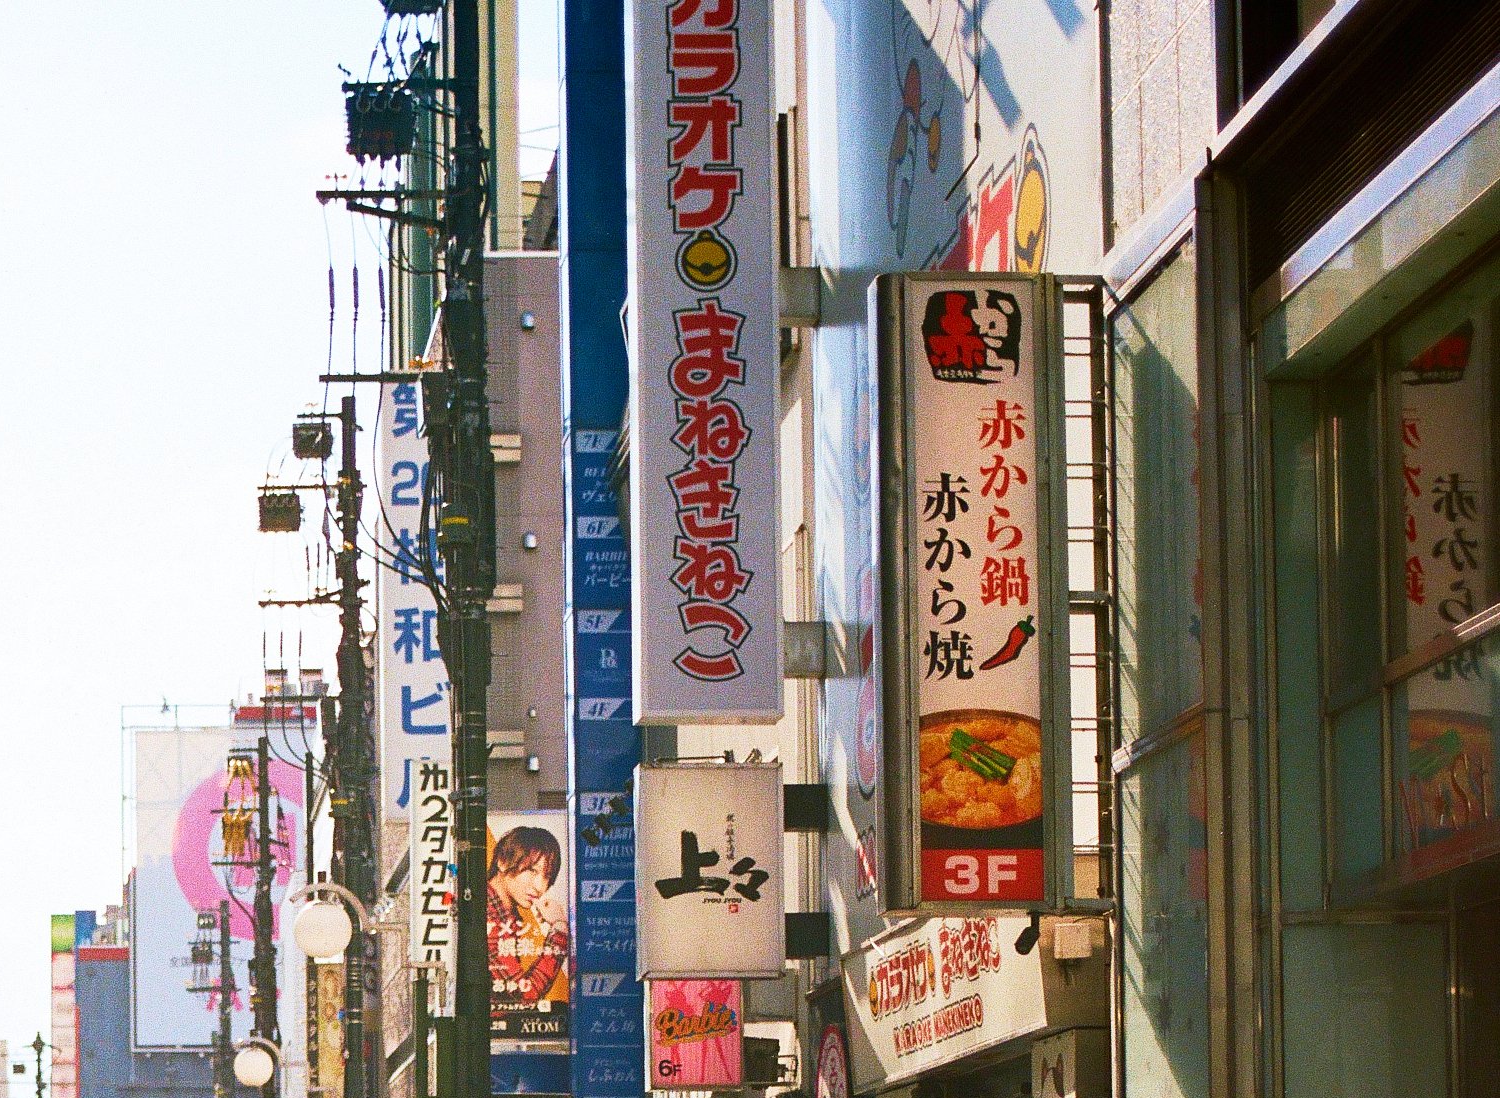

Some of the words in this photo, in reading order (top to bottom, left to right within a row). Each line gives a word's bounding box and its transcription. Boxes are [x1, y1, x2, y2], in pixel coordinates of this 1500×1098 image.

[668, 300, 753, 684] まねきねこ
[976, 400, 1032, 609] 赤から鍋
[921, 473, 975, 683] 赤から焼
[654, 829, 771, 901] 上々
[942, 854, 1018, 895] 3F
[875, 940, 928, 1014] カラオケ
[938, 916, 1002, 998] まねきねこ
[520, 1022, 560, 1033] ATOM
[655, 1002, 737, 1042] Barbie
[893, 1015, 933, 1057] KARAOKE
[933, 993, 984, 1042] MANEKINEKO
[658, 1059, 683, 1078] 6F
